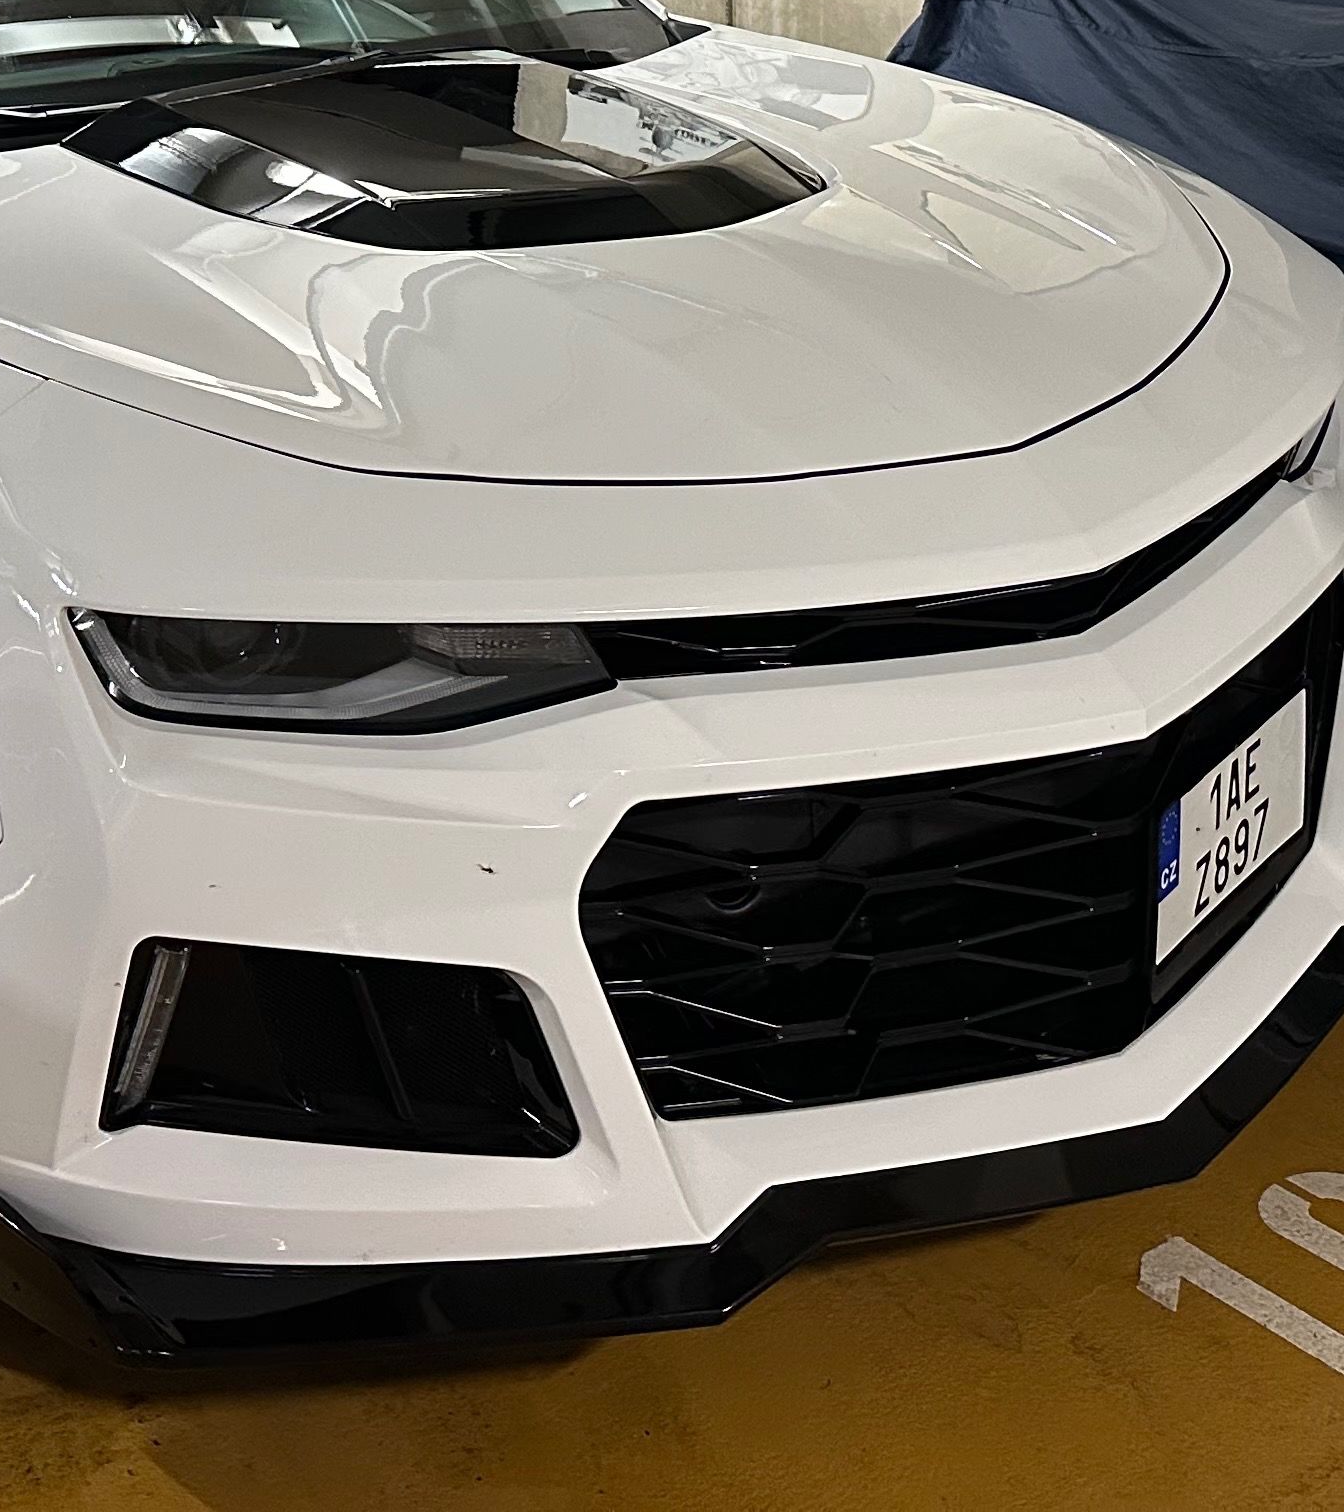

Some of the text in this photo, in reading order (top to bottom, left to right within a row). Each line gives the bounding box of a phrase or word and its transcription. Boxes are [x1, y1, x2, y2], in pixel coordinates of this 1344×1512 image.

[1209, 738, 1261, 831] 1AE
[1160, 859, 1177, 890] CZ
[1193, 797, 1270, 918] Z897
